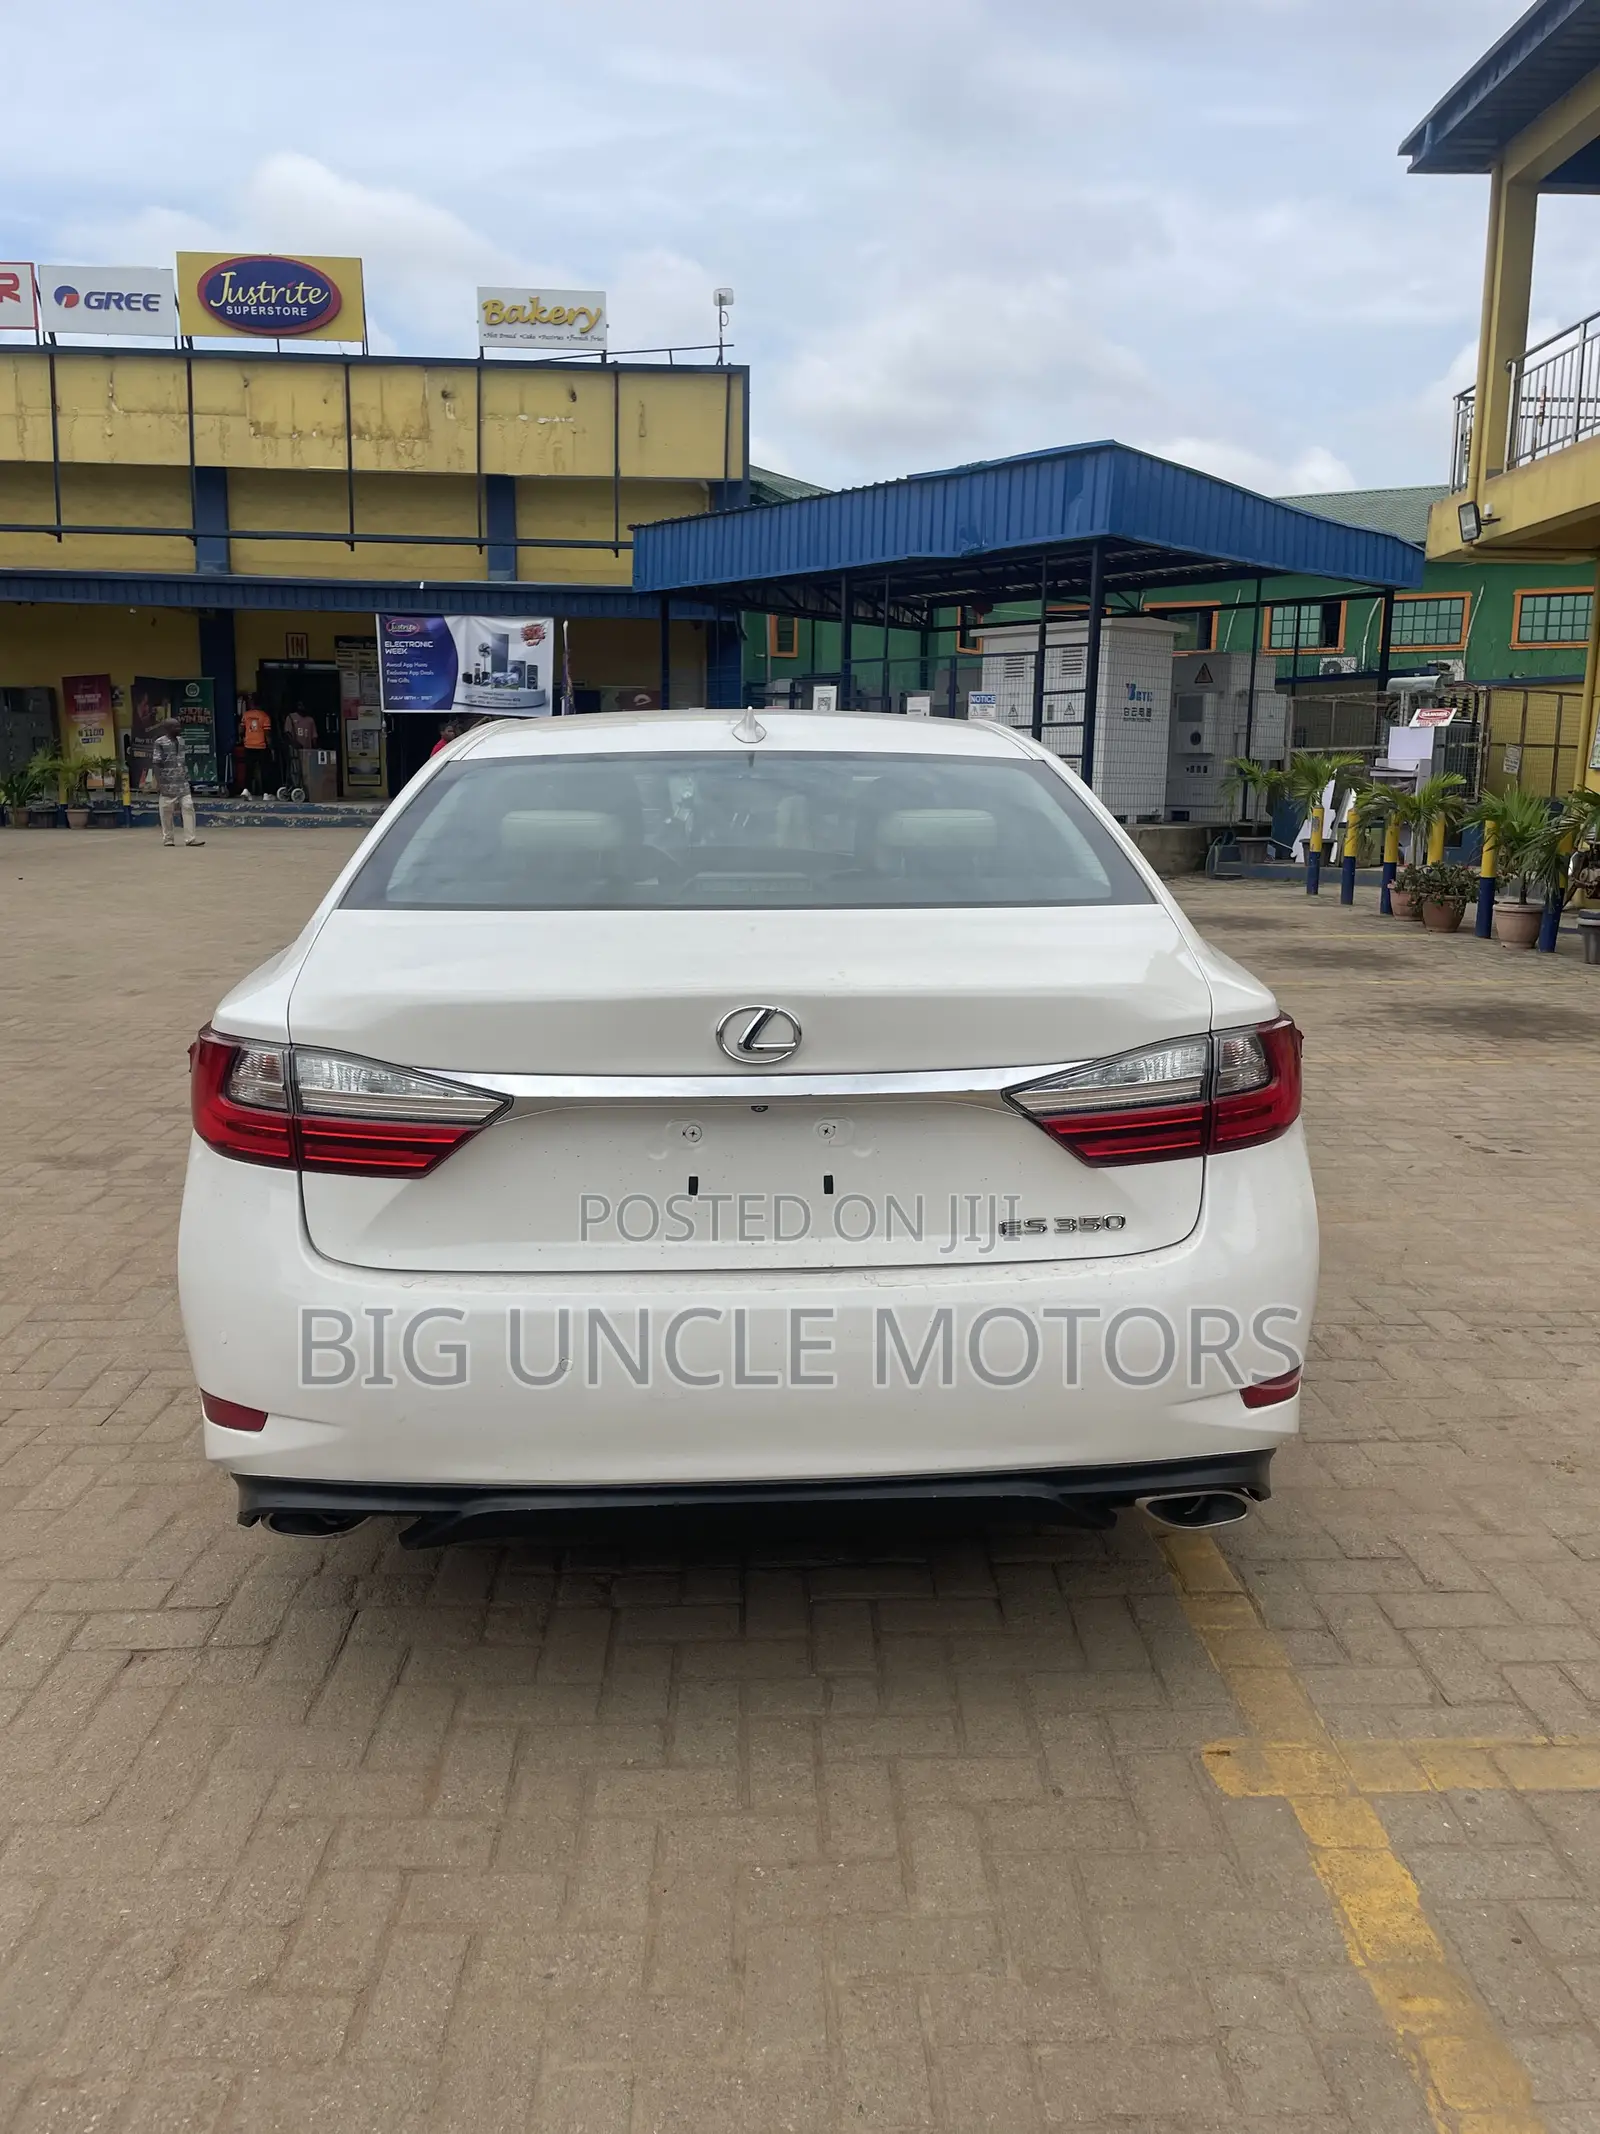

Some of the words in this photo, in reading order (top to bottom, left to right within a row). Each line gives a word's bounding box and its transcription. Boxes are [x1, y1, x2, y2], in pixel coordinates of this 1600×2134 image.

[209, 271, 329, 307] Justrite
[84, 291, 161, 312] GREE
[226, 305, 308, 316] SUPERSTORE
[482, 296, 602, 334] Bakery
[971, 695, 996, 703] NOTICE
[999, 1217, 1048, 1236] ES
[1053, 1213, 1126, 1234] 350
